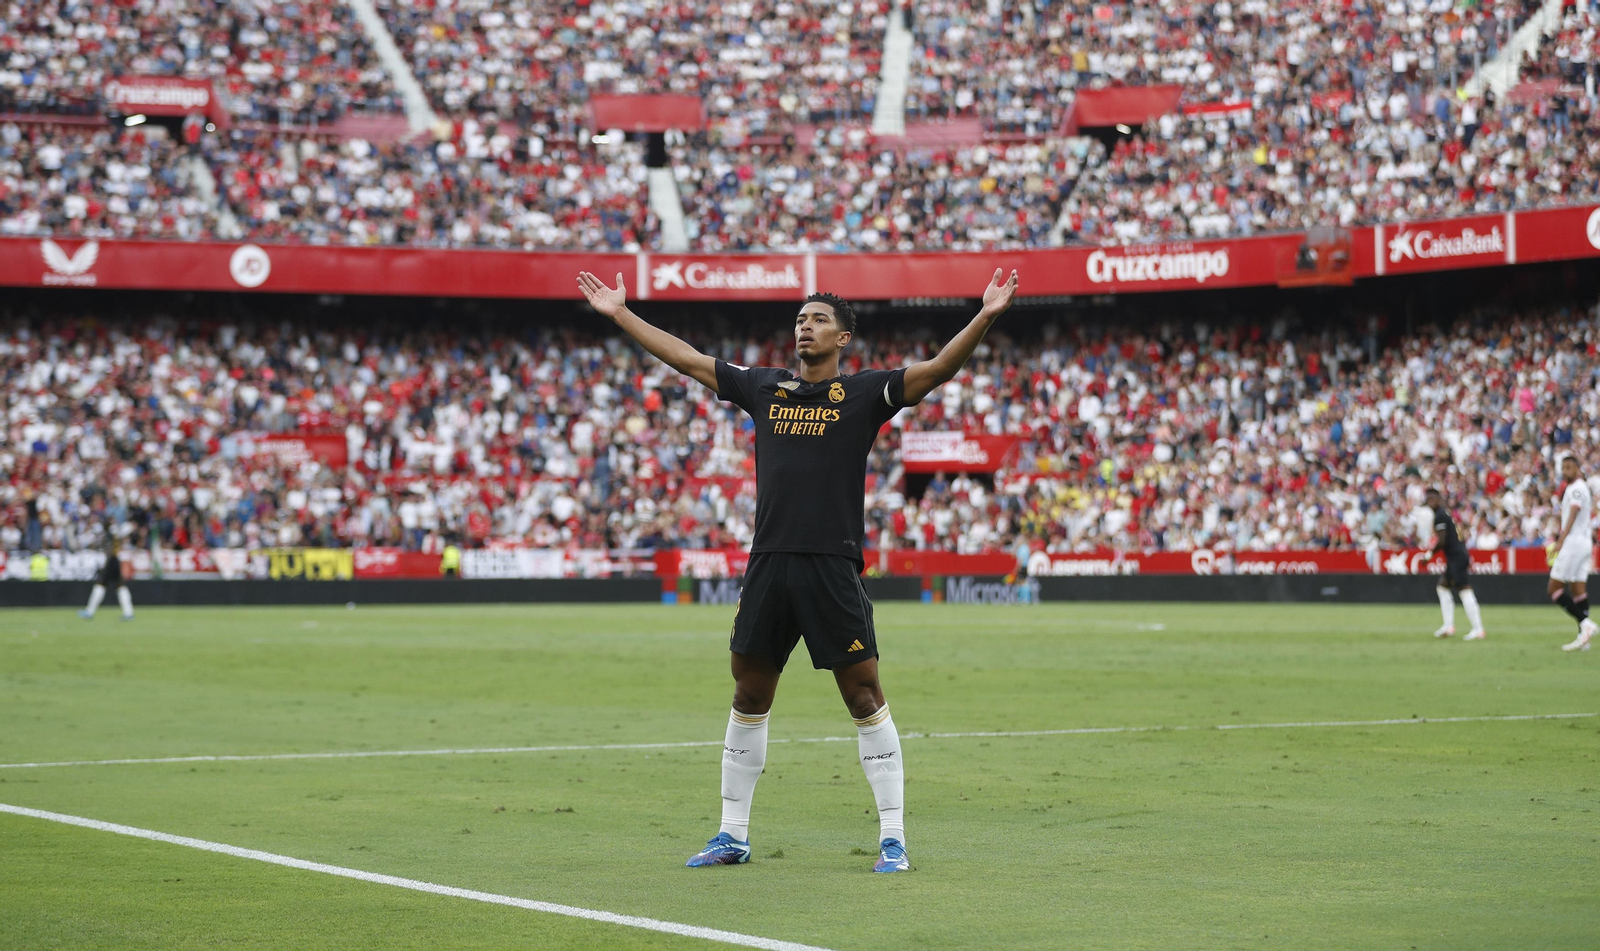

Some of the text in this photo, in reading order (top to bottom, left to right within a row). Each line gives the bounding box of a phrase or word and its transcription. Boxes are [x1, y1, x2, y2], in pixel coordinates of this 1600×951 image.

[1414, 225, 1505, 259] CaixaBank
[684, 262, 801, 289] CaixaBank
[1086, 248, 1230, 283] Cruzcampo
[768, 404, 840, 421] Emirates
[774, 421, 826, 436] FLY BETTER
[946, 575, 1041, 605] Microsot
[863, 750, 896, 761] RMCF
